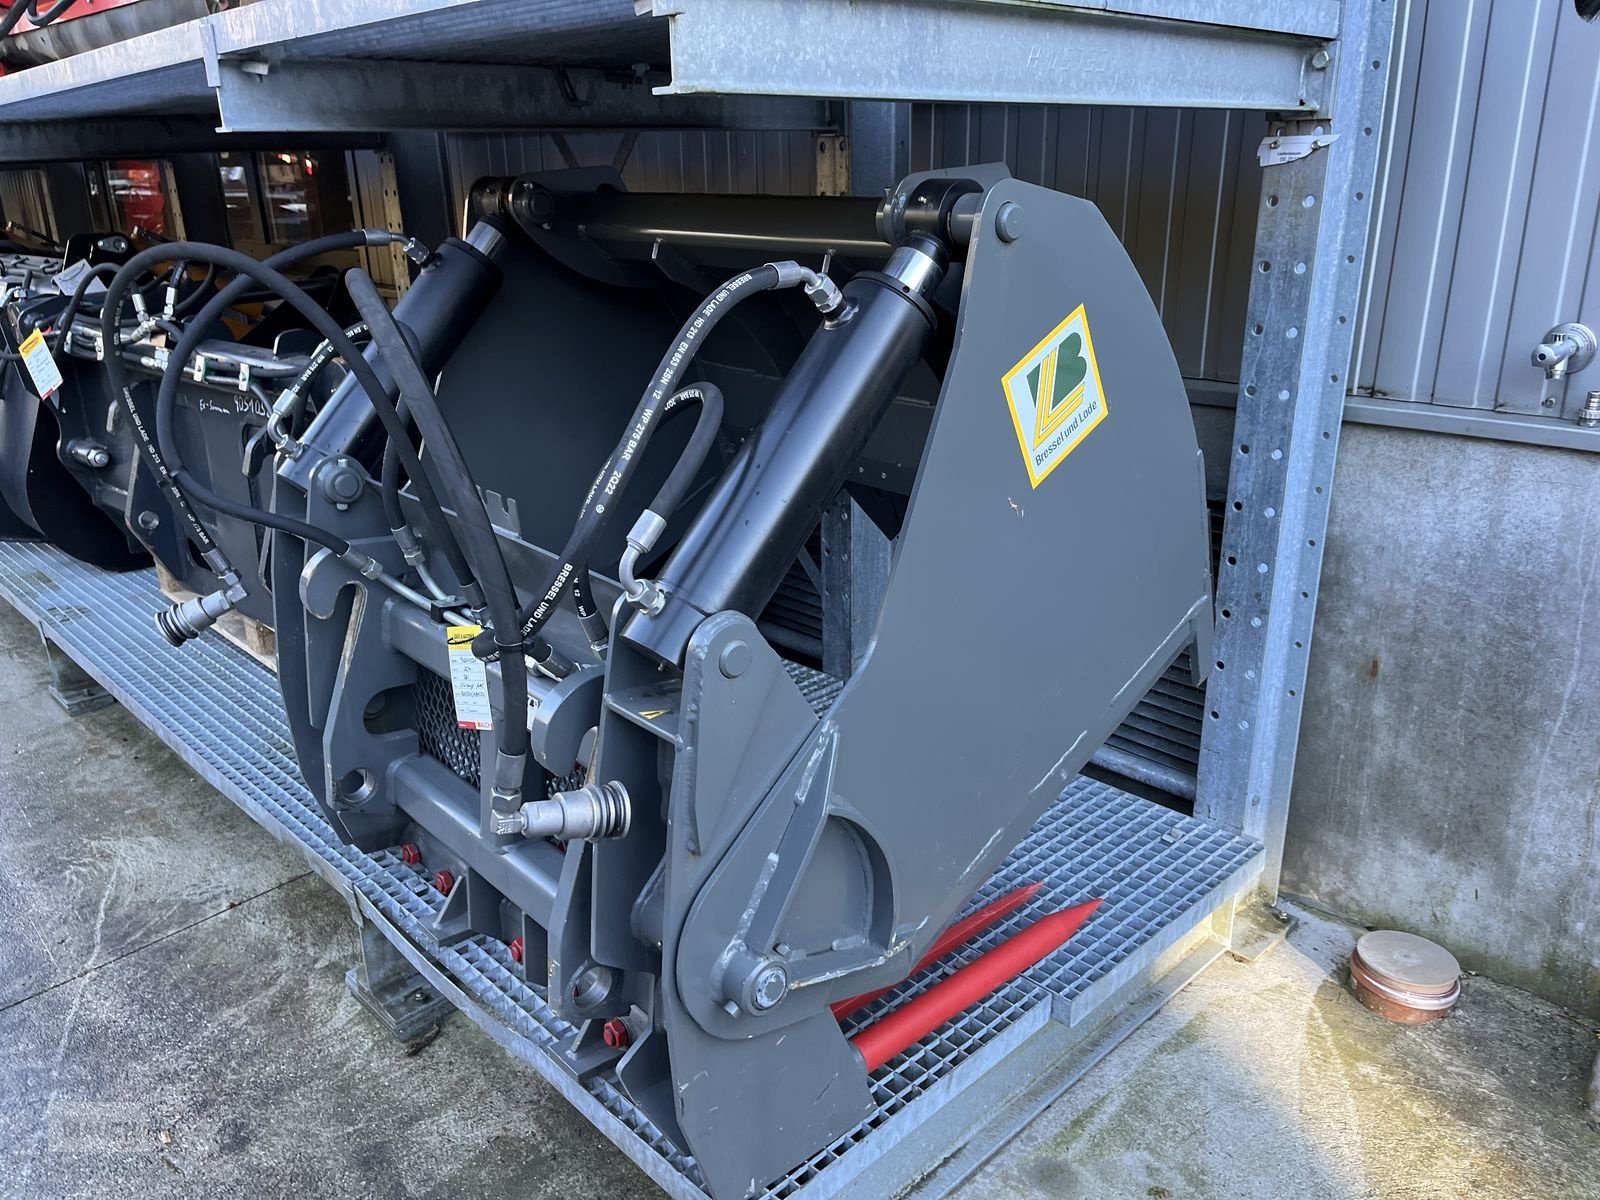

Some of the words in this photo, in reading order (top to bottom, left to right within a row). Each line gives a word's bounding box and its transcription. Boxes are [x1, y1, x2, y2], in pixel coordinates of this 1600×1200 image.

[726, 273, 752, 291] BRESSEL
[715, 289, 729, 302] UND
[702, 299, 719, 317] LADE
[694, 316, 705, 328] HD
[686, 326, 698, 339] 213
[677, 341, 689, 354] EN
[660, 367, 674, 385] 2SN
[652, 389, 663, 400] 12
[641, 408, 654, 424] WP
[138, 426, 150, 442] LADE
[632, 423, 645, 441] 275
[1035, 432, 1064, 466] Bressel
[1063, 418, 1079, 438] und
[1078, 401, 1098, 423] Lade
[621, 439, 638, 461] BAR
[604, 470, 622, 495] 2Q22
[544, 563, 573, 600] BRESSEL
[533, 601, 549, 618] UND
[578, 605, 587, 617] WP
[520, 617, 538, 636] LADE
